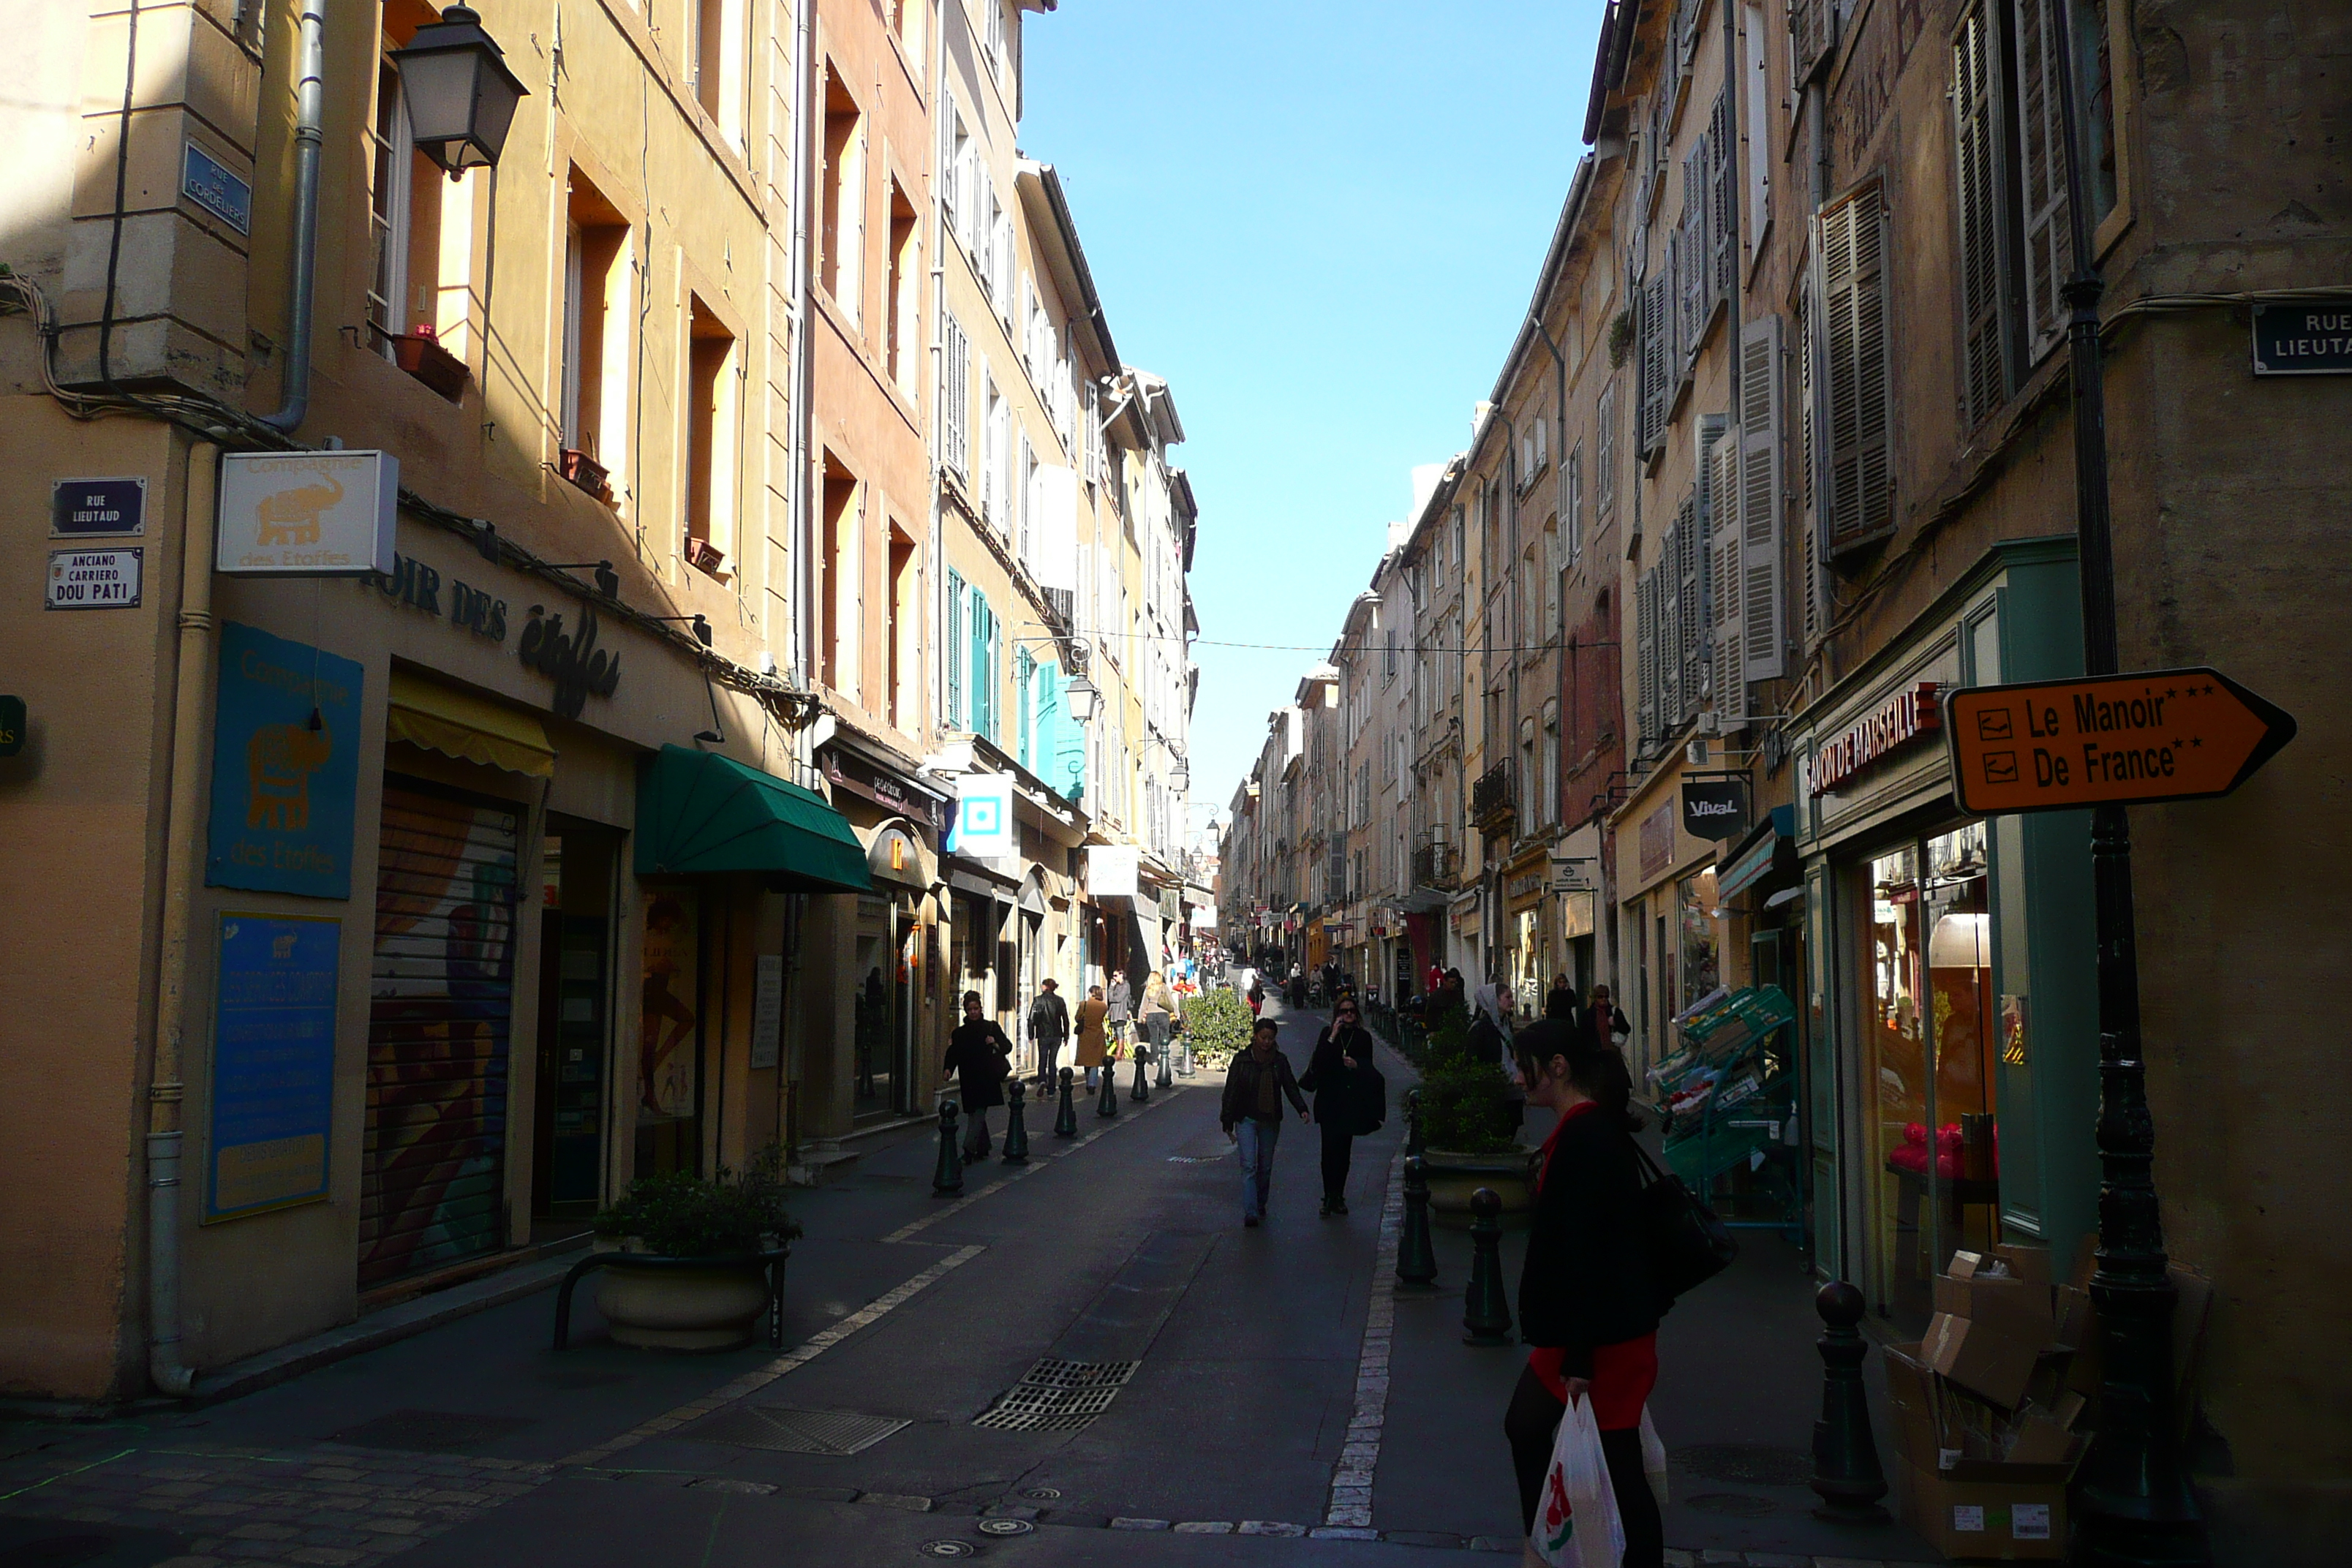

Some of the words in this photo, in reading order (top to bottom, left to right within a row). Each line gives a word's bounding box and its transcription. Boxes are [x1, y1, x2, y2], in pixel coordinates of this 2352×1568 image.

[211, 165, 228, 183] RUE
[213, 182, 225, 195] DES
[189, 178, 245, 225] CORDELIERS
[2306, 314, 2352, 331] RUE
[247, 458, 363, 474] Compagnie
[86, 495, 106, 507] RUE
[72, 510, 120, 523] LIEUTAUD
[72, 555, 116, 567] ANCIANO
[239, 551, 274, 566] des
[282, 549, 351, 566] Etoffes
[69, 569, 118, 581] CARRIERO
[57, 584, 85, 601] DOU
[93, 583, 127, 600] PATI
[451, 579, 507, 642] DES
[241, 649, 350, 707] Compagnie
[2026, 698, 2059, 738] Le
[2073, 688, 2166, 735] Manoir
[1837, 733, 1852, 778] DE
[1854, 682, 1925, 769] MARSEILLE
[2033, 747, 2069, 788] De
[2083, 742, 2175, 784] France
[230, 838, 267, 867] des
[274, 840, 335, 875] Etoffes
